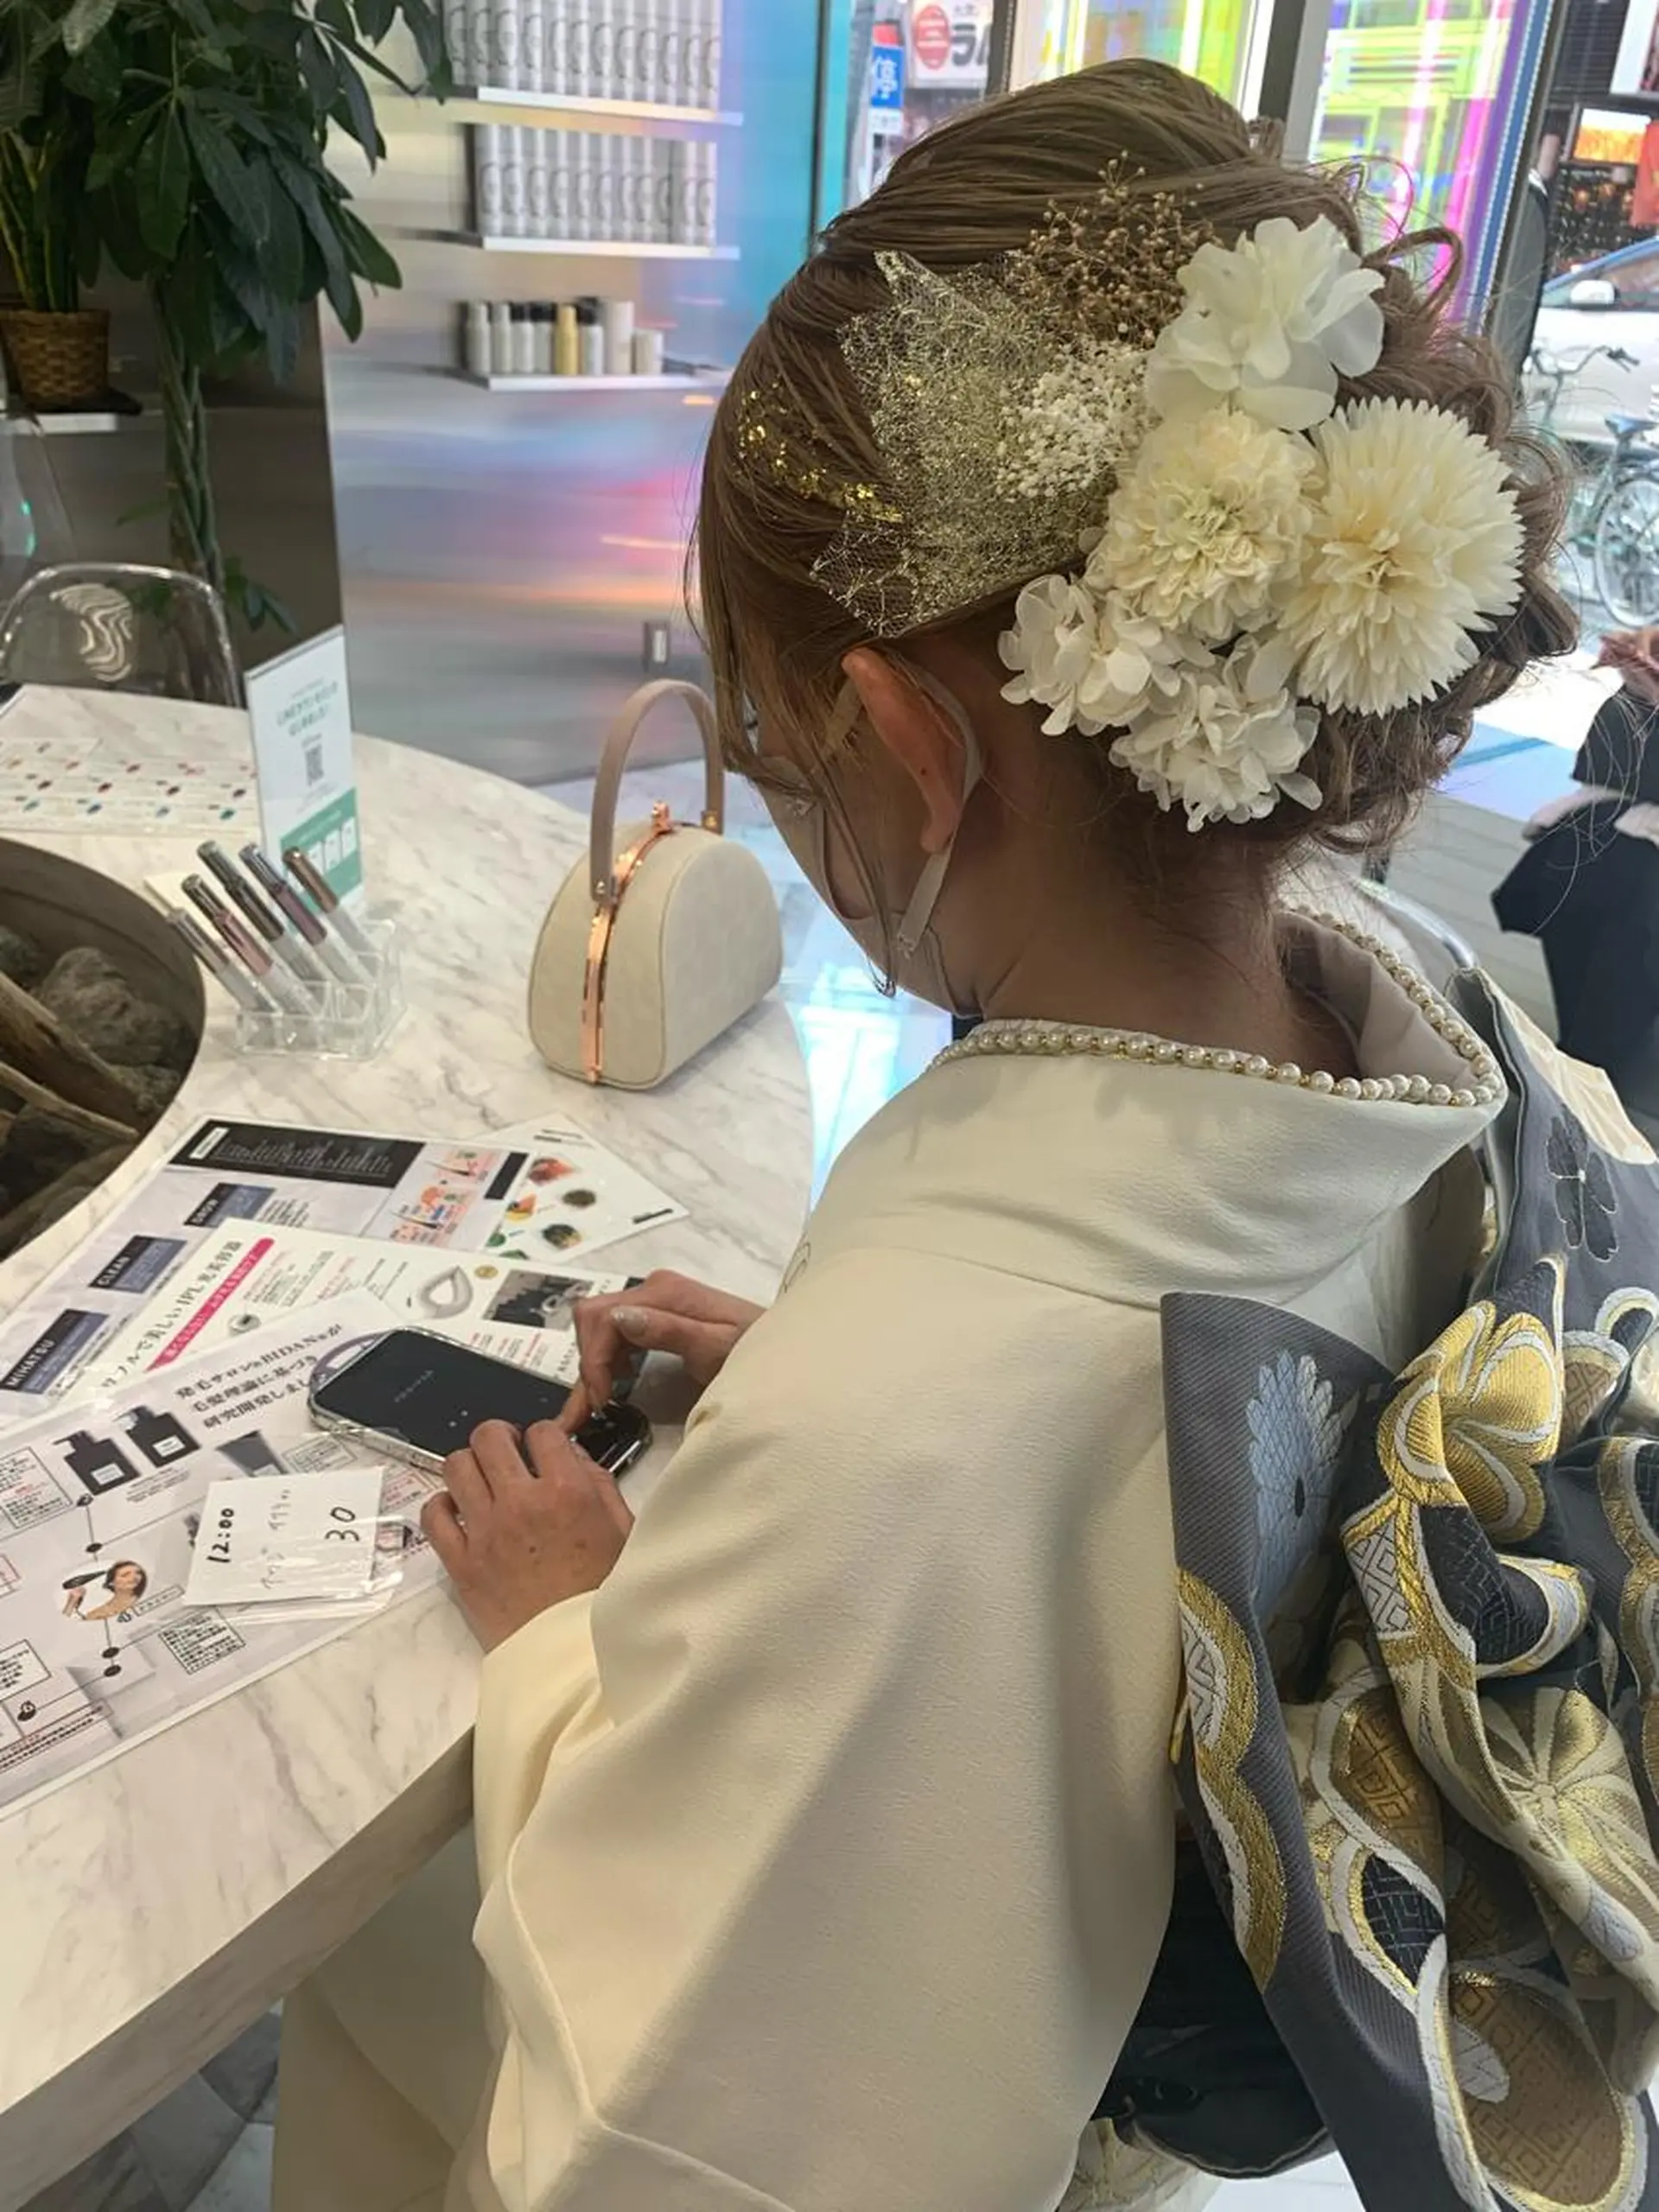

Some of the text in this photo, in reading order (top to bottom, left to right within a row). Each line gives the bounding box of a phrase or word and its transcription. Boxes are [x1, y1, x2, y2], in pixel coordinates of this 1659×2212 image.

[203, 1377, 312, 1428] 研究開発しまし
[207, 1508, 234, 1563] 12:00
[324, 1506, 359, 1541] 30
